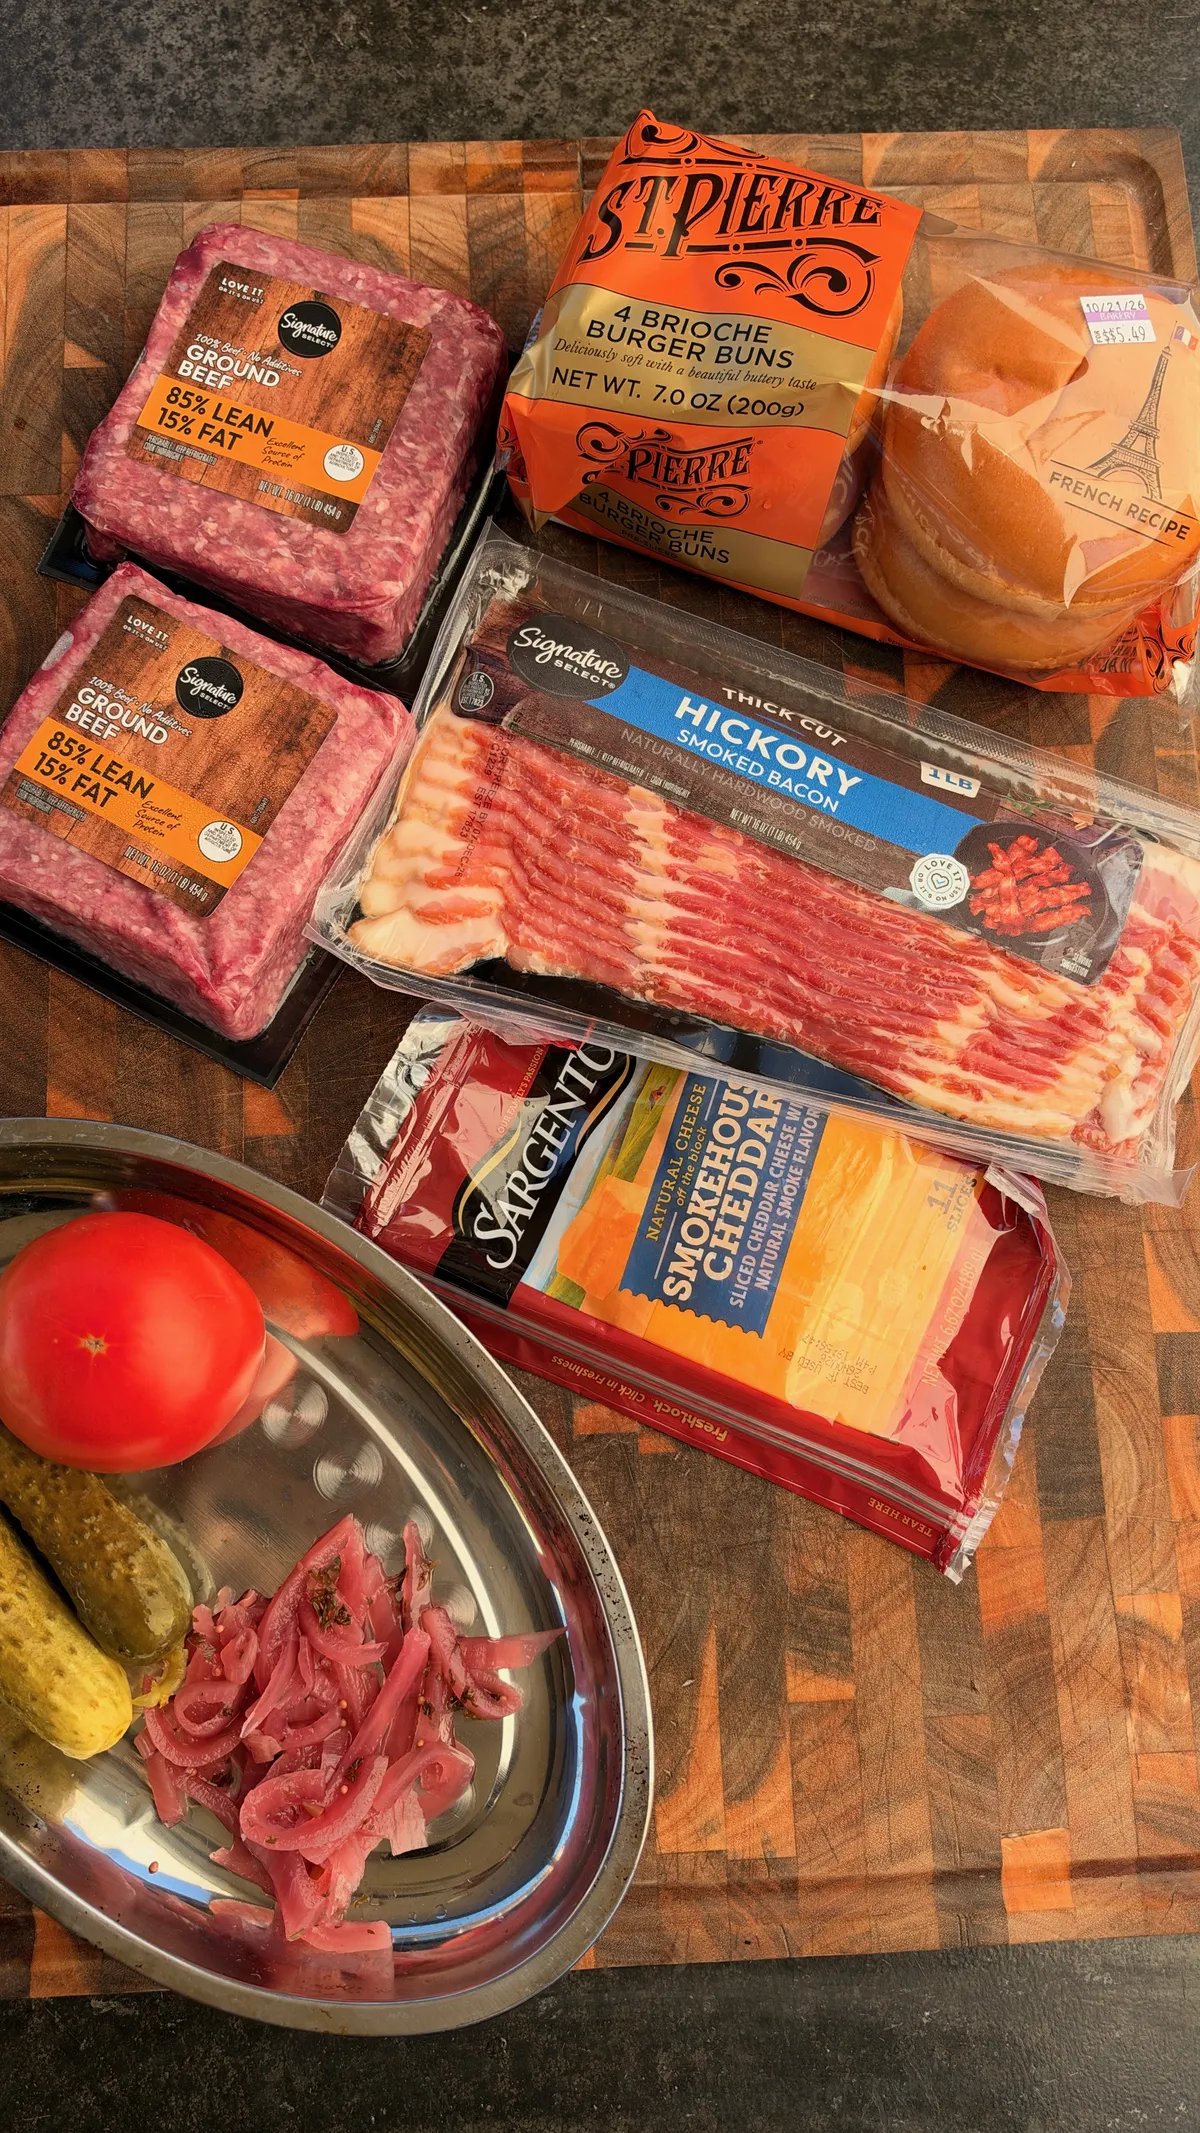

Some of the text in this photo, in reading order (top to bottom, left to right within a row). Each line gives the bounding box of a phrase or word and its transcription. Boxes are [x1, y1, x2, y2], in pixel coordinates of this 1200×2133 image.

[222, 278, 264, 296] LOVE IT
[1086, 300, 1145, 314] 10/21/26
[280, 313, 338, 342] Signature
[614, 305, 772, 344] 4 BRIOCHE
[1100, 312, 1136, 320] BAKERY
[194, 333, 303, 377] 100% Beef No Additives
[586, 319, 795, 369] BURGER BUNS
[177, 360, 234, 390] BEEF
[186, 344, 280, 387] GROUND
[554, 338, 817, 391] Deliciously soft with a beautiful buttery taste
[166, 386, 275, 438] 85% LEAN
[552, 367, 805, 418] NET WT. 7.0 OZ (200g)
[157, 407, 196, 436] 15%
[197, 423, 243, 450] FAT
[266, 437, 305, 451] Excellent
[261, 456, 293, 468] Protein
[262, 446, 305, 461] Source of
[341, 445, 355, 455] U.S.
[625, 444, 754, 485] PIERRE
[258, 480, 341, 520] NET WT. 16 OZ (1 LB) 454 g
[597, 491, 714, 544] 4 BRIOCHE
[1050, 471, 1190, 540] FRENCH RECIPE
[579, 492, 730, 564] BURGER BUNS
[622, 529, 677, 558] PRE-SLICED
[127, 615, 169, 642] LOVE IT
[514, 627, 622, 679] Signature
[180, 667, 236, 704] Signature
[472, 673, 485, 684] U.S.
[64, 703, 121, 740] BEEF
[77, 687, 169, 745] GROUND
[88, 676, 193, 738] 100% Beef No Additives
[722, 687, 847, 747] THICK CUT
[47, 731, 154, 800] 85% LEAN
[497, 749, 509, 764] OR
[601, 752, 612, 763] KEEP
[675, 696, 862, 796] HICKORY
[33, 752, 73, 785] 15%
[71, 773, 118, 808] FAT
[484, 768, 505, 809] FREEZE
[621, 727, 876, 851] NATURALLY HARDWOOD SMOKED
[677, 729, 839, 813] SMOKED BACON
[928, 767, 973, 790] 1 LB
[141, 800, 183, 821] Excellent
[474, 786, 487, 809] EST
[133, 819, 165, 838] Protein
[134, 809, 180, 831] Source of
[220, 823, 235, 835] U.S.
[460, 809, 477, 838] 17823
[476, 812, 488, 828] BY
[455, 829, 481, 877] 07-DEC-26
[924, 859, 962, 882] LOVE IT
[124, 846, 208, 902] NET WT. 16 OZ (1 LB) 454 g
[1060, 960, 1088, 978] SUGGESTION
[1070, 951, 1093, 968] SERVING
[496, 1046, 545, 1134] OUR FAMILY'S PASSION
[474, 1046, 616, 1269] SARGENTO
[645, 1083, 706, 1241] NATURAL CHEESE
[676, 1127, 708, 1206] off the block
[702, 1090, 783, 1281] CHEDDAR
[754, 1108, 822, 1291] NATURAL SMOKE FLAVOR
[927, 1179, 958, 1214] 11
[947, 1174, 978, 1233] SLICES
[729, 1124, 797, 1308] SLICED CHEDDAR CHEESE
[919, 1246, 987, 1387] NET 6.67 OZ (189 g)
[551, 1355, 606, 1385] Freshness
[607, 1380, 619, 1390] in
[777, 1346, 870, 1394] BEST IF USED BY
[619, 1385, 646, 1402] Click
[868, 1497, 932, 1537] TEAR HERE
